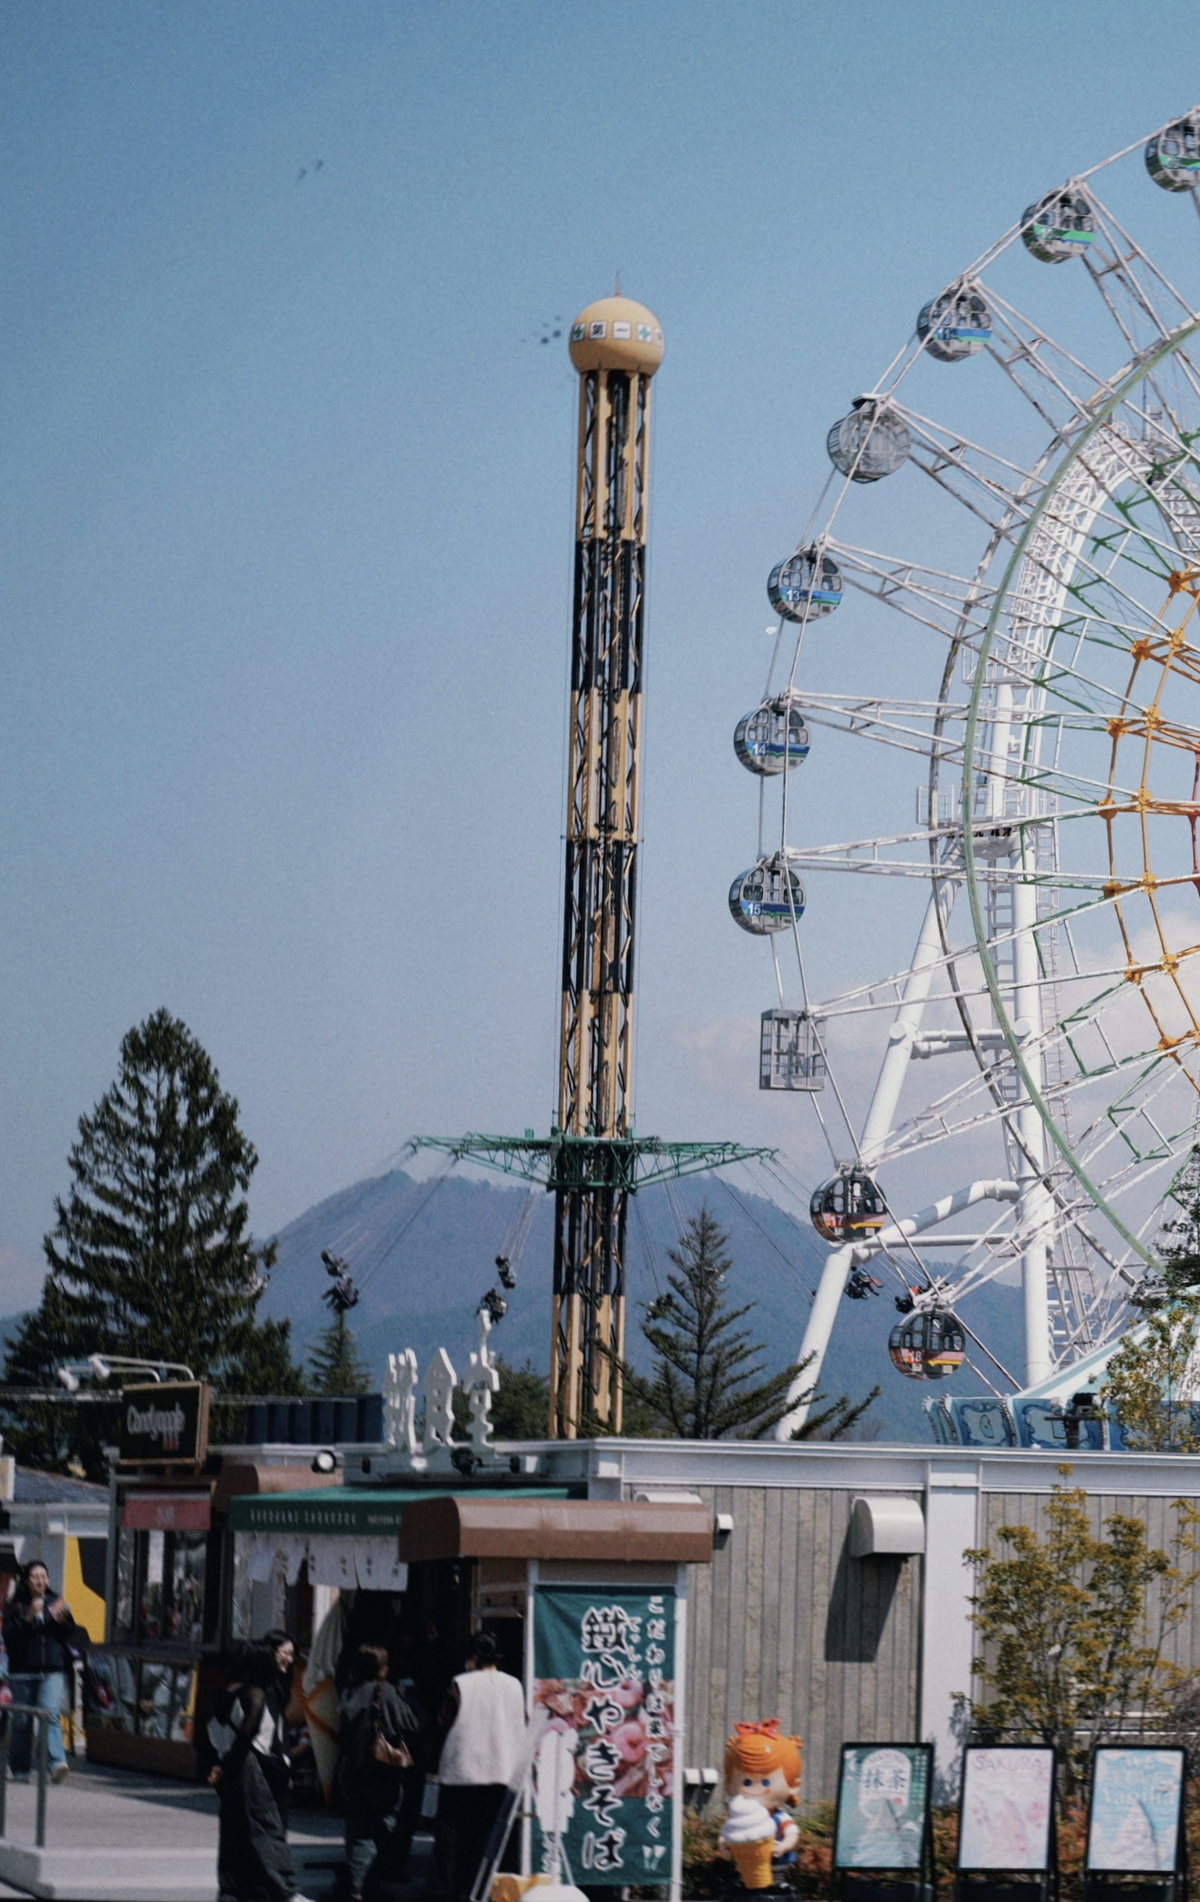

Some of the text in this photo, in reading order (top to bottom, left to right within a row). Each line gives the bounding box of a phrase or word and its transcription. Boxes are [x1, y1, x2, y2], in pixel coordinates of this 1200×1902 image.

[787, 589, 801, 603] 13
[752, 744, 766, 755] 14
[748, 903, 762, 915] 15
[831, 1215, 845, 1227] 17
[909, 1351, 923, 1362] 18
[975, 1755, 1043, 1772] SAKURA
[864, 1767, 908, 1790] 抹茶
